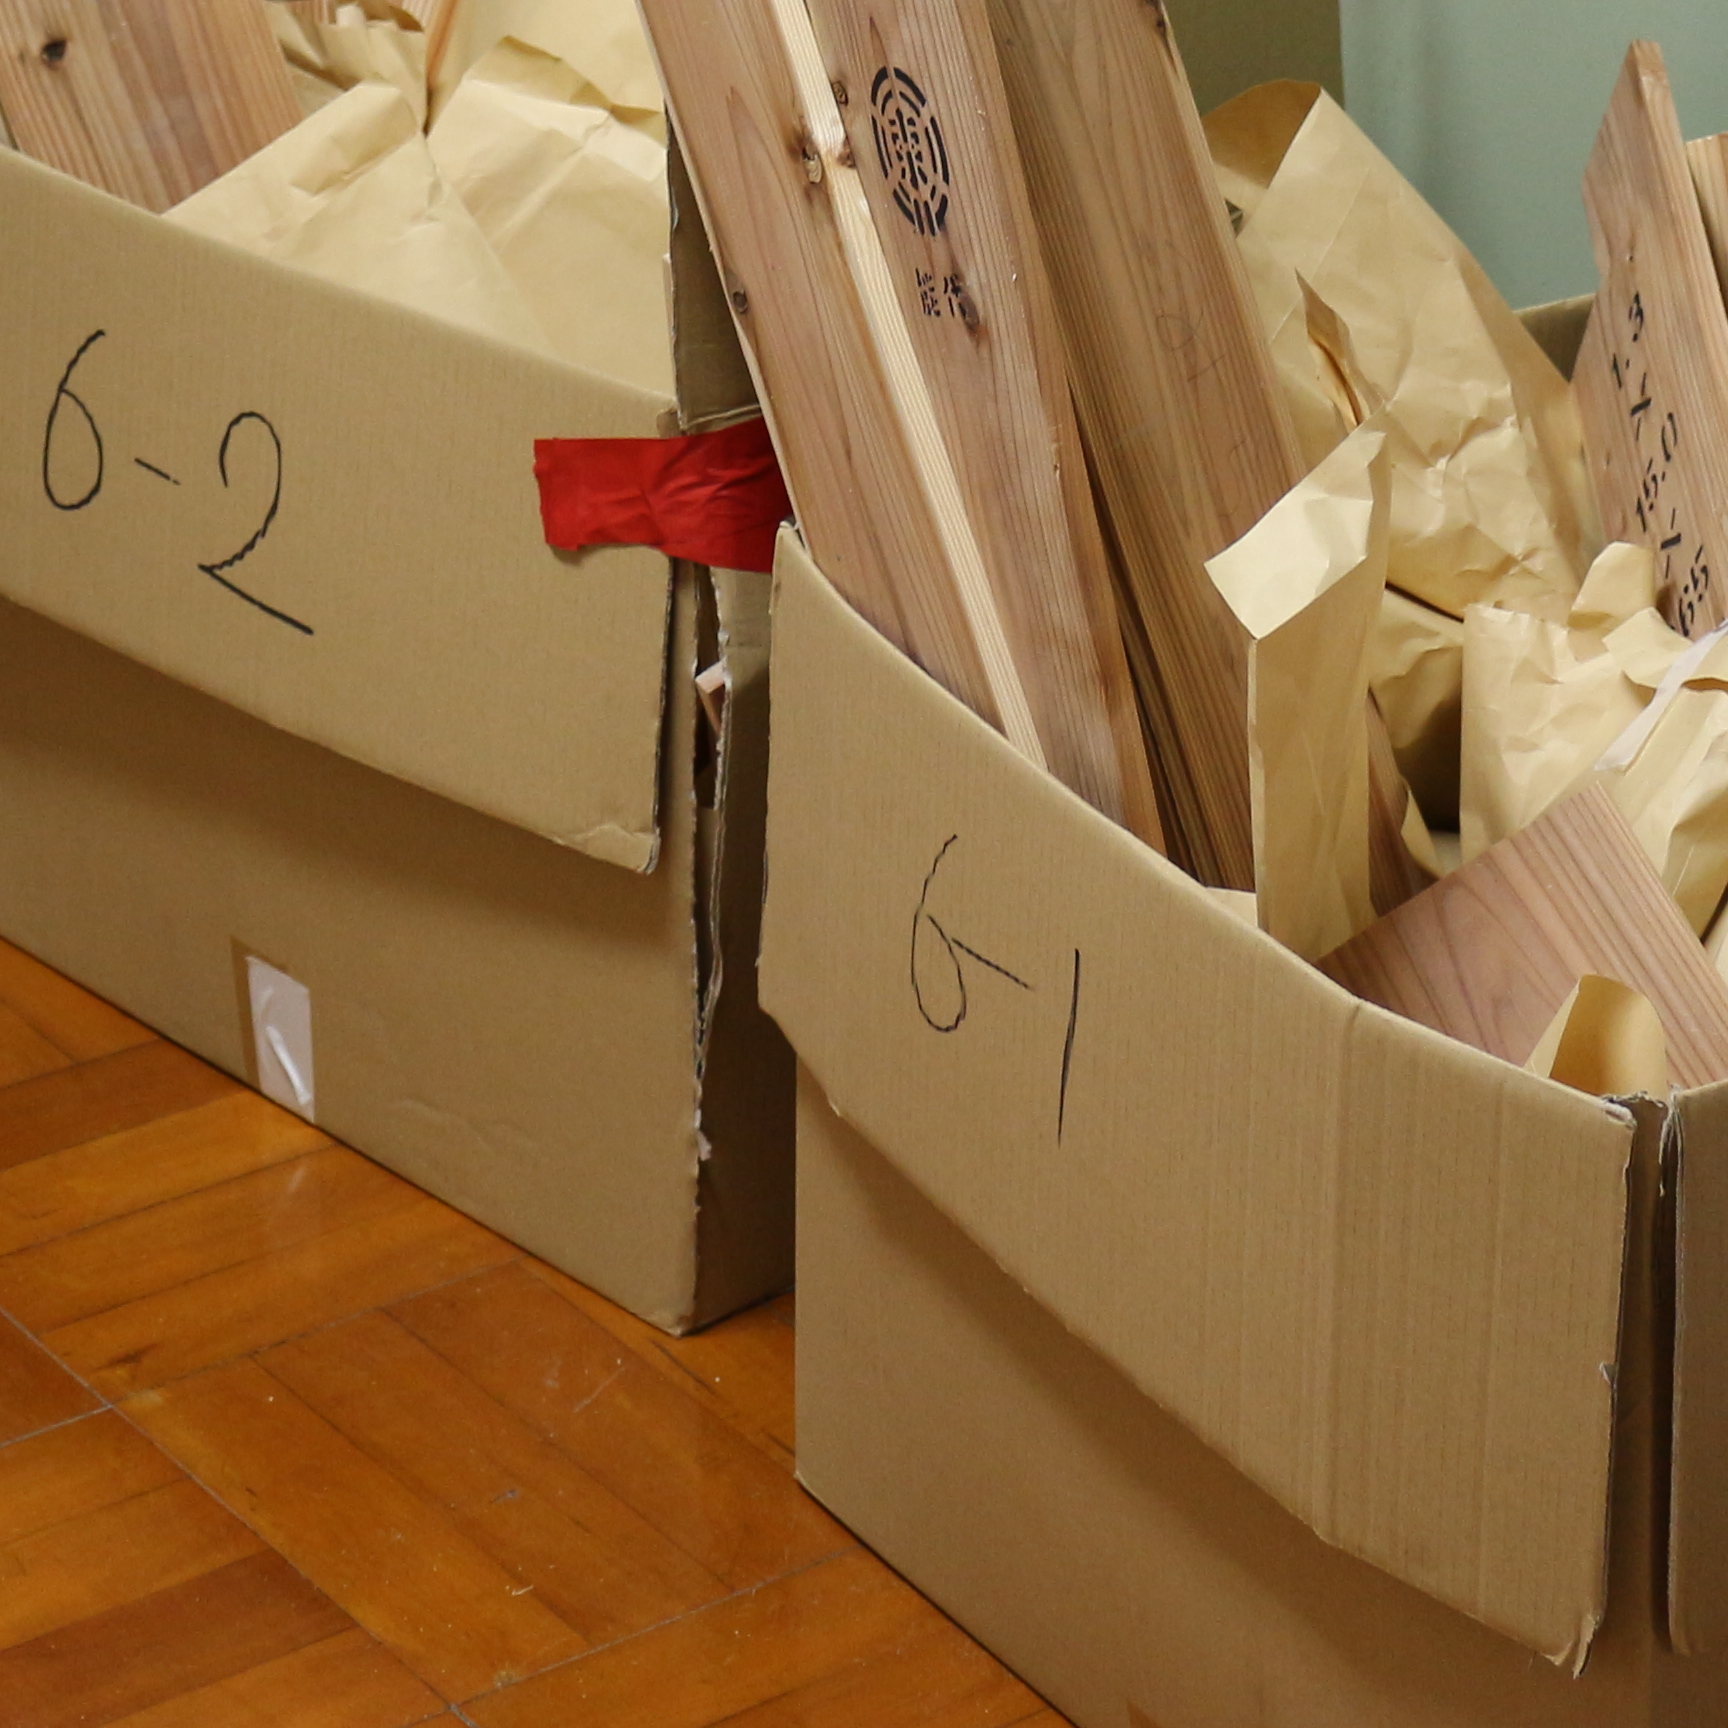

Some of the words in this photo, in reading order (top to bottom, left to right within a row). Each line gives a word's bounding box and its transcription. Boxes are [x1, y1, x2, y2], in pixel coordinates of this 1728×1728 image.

[41, 327, 315, 636] 6-2
[1634, 411, 1679, 533] 15.0
[1669, 544, 1710, 638] 65
[910, 832, 1082, 1151] 6-1
